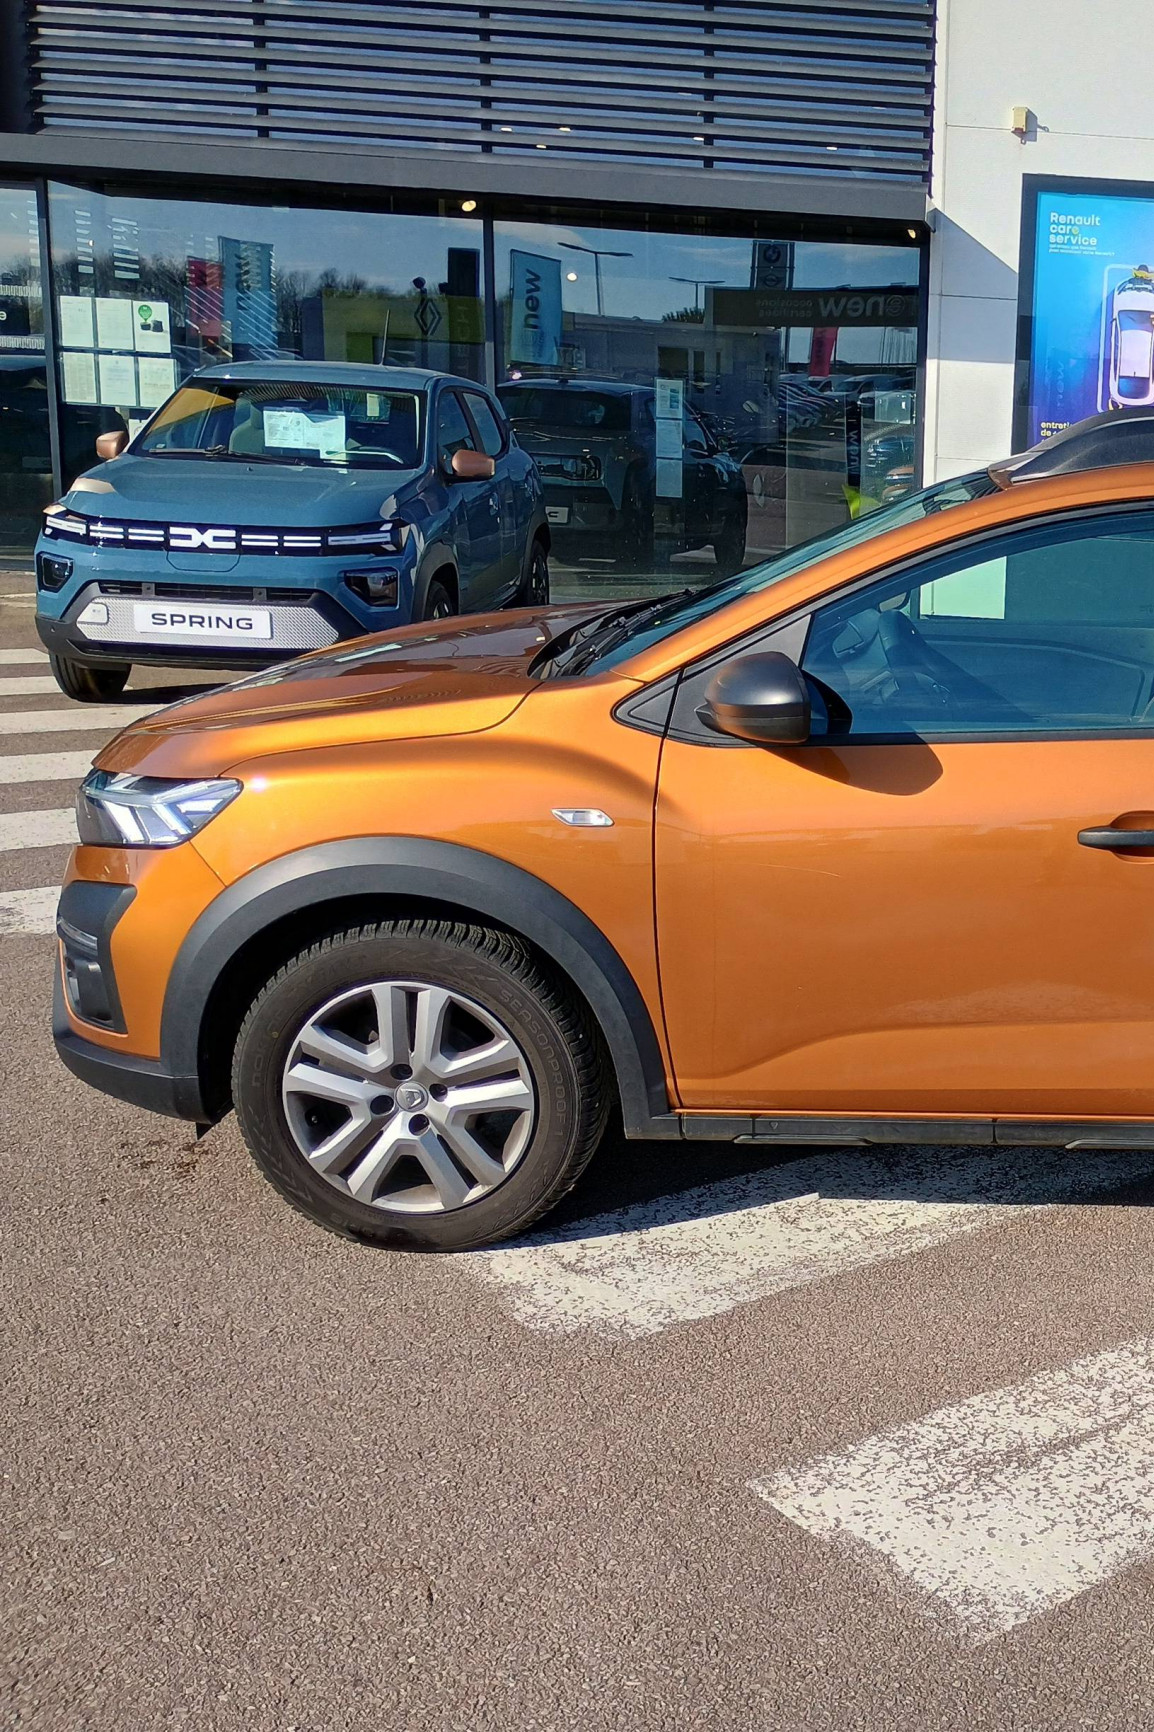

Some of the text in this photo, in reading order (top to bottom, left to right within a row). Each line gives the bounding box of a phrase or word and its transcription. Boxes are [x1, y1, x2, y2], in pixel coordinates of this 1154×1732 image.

[1049, 212, 1101, 226] Renault
[1049, 224, 1080, 235] care
[1049, 234, 1098, 246] service
[1040, 422, 1073, 430] entreti
[151, 612, 253, 630] SPRING
